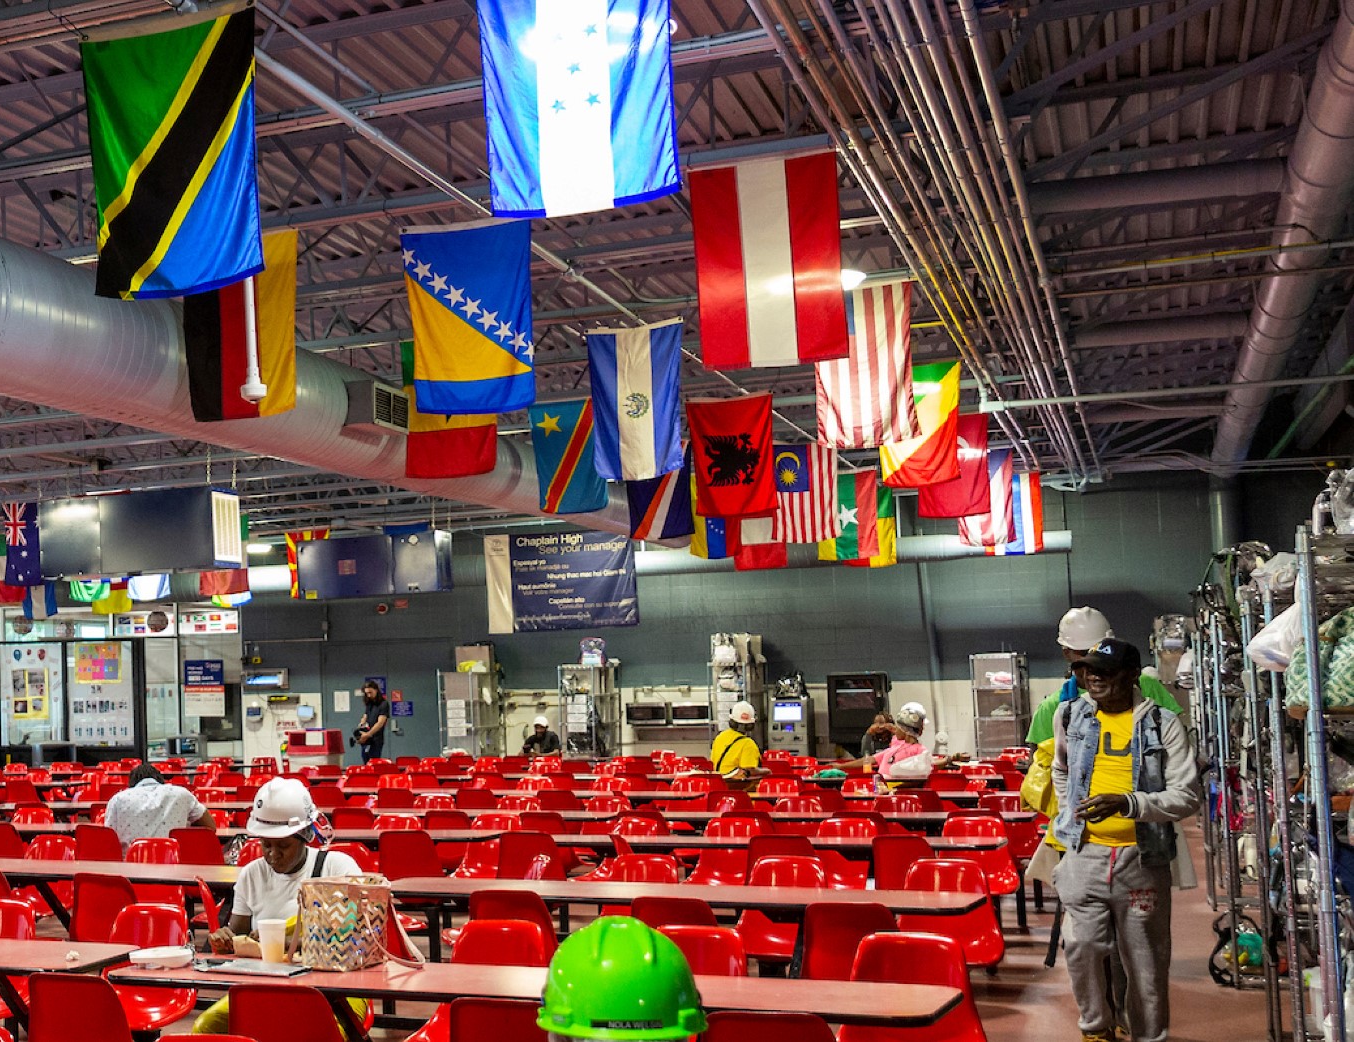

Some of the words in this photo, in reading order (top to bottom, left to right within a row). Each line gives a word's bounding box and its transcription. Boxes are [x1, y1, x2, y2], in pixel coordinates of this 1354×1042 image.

[516, 536, 558, 547] Chaplain
[560, 534, 583, 545] High
[539, 546, 558, 554] See
[560, 544, 582, 556] your
[584, 541, 627, 552] manager
